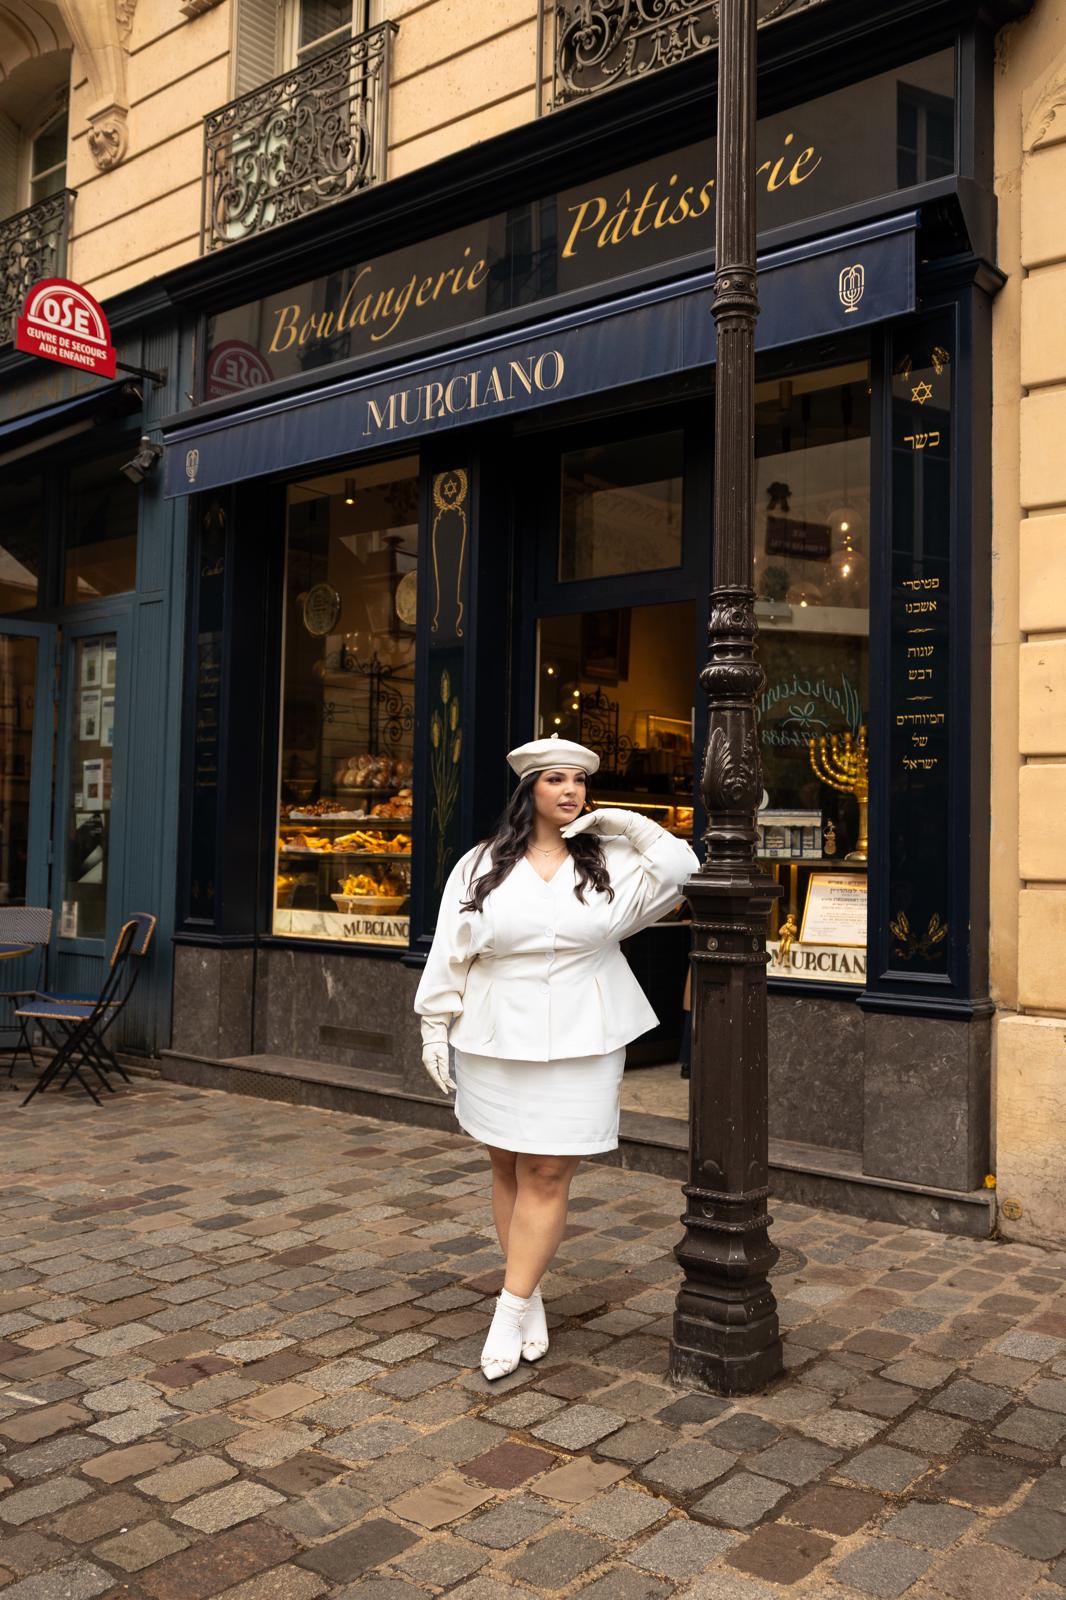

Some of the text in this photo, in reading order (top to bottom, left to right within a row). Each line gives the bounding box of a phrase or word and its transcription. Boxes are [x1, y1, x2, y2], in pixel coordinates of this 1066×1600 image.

[268, 133, 823, 355] Boulangerie Pâtissrie
[43, 297, 90, 335] OSE
[27, 326, 107, 361] ŒUVRE DE SECOURS
[39, 342, 95, 367] AUX ENFANTS
[362, 349, 565, 436] MURCIANO
[903, 431, 940, 449] כשר
[908, 668, 933, 681] דבש
[911, 732, 928, 748] של
[902, 755, 938, 770] ישראל
[343, 920, 409, 938] MURCIANO
[771, 949, 867, 974] MURCIAN
